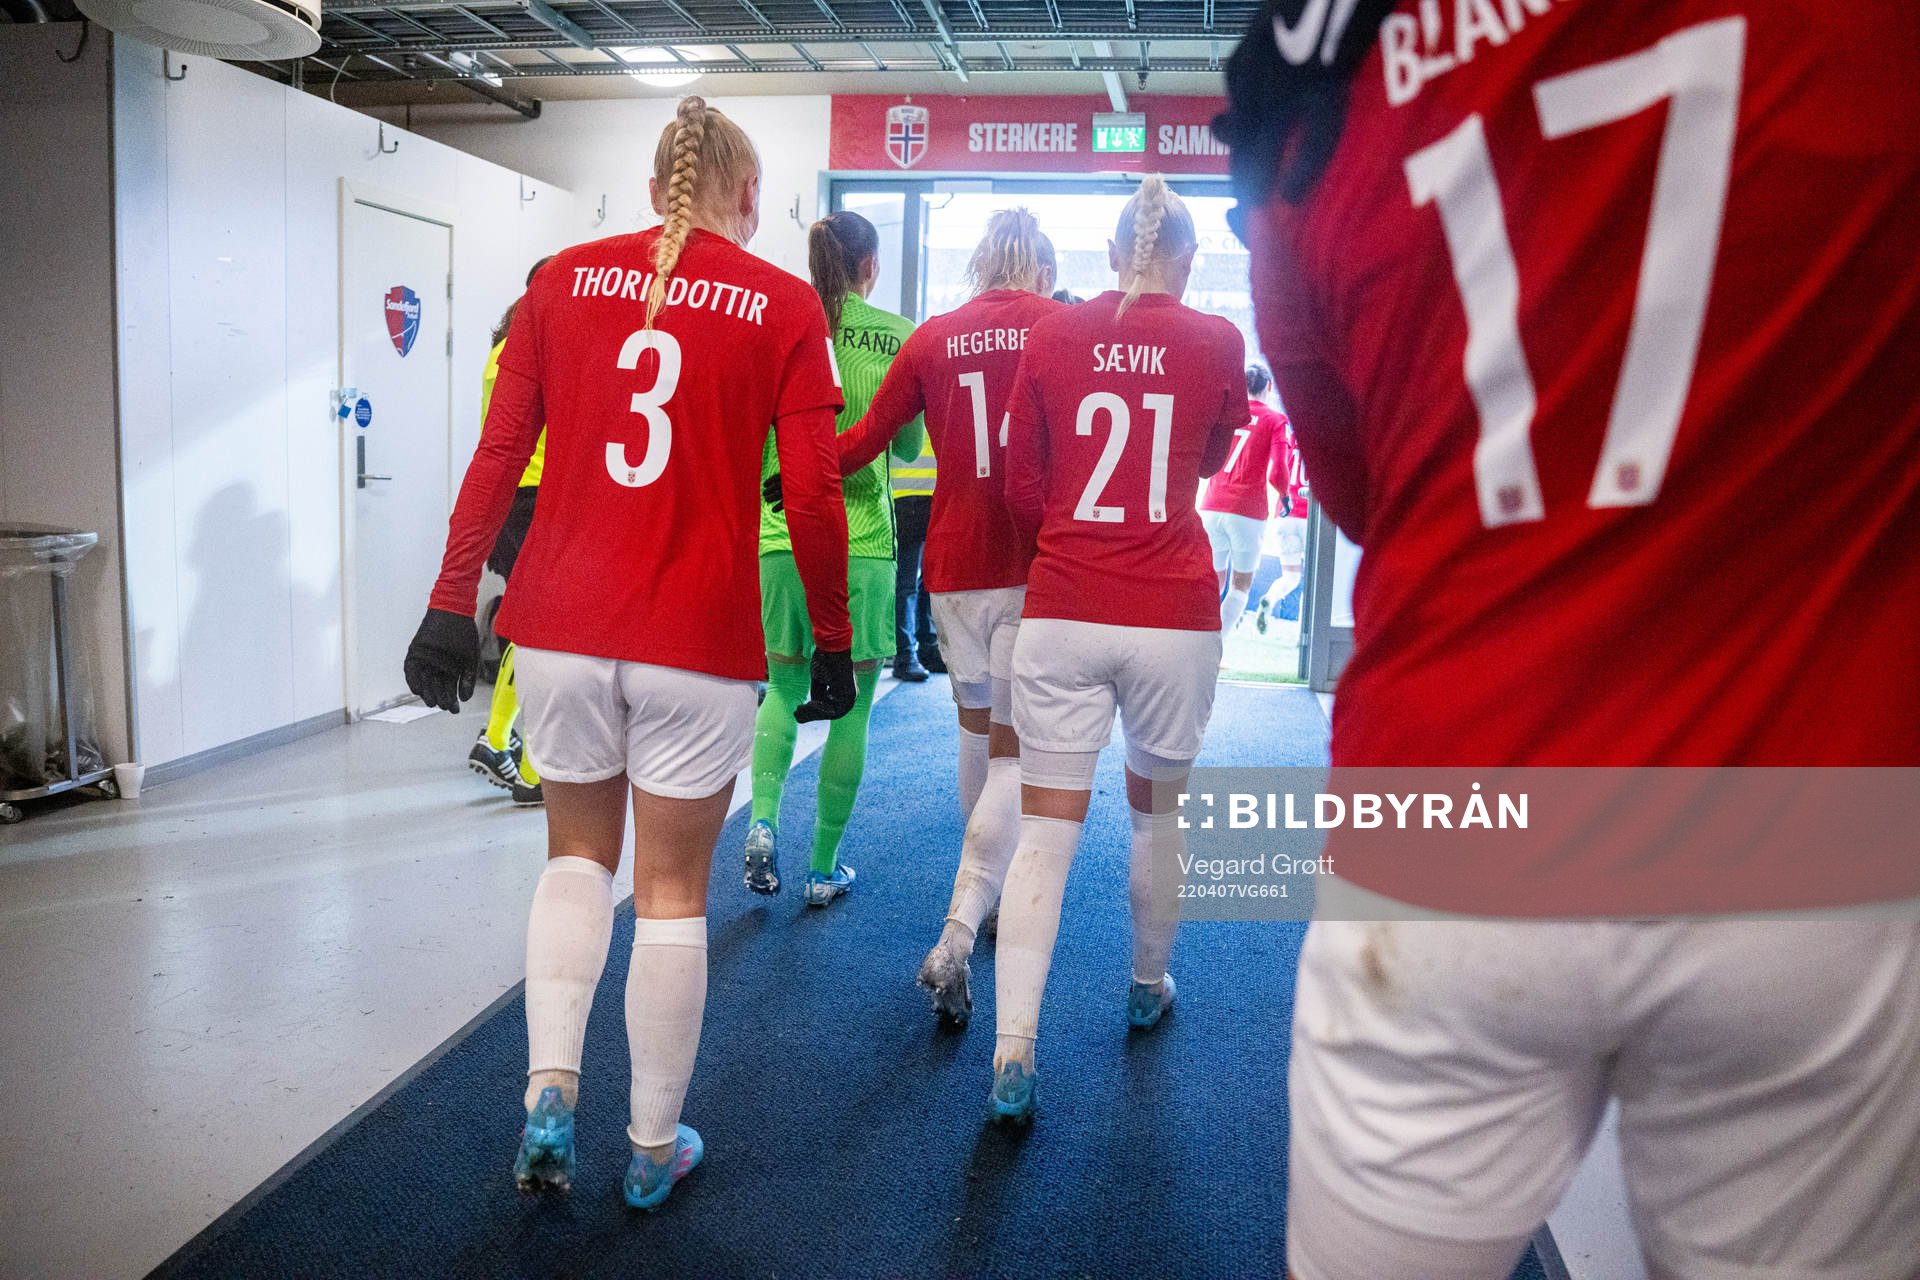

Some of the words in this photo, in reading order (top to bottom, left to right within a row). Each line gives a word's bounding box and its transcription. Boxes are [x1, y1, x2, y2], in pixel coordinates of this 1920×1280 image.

[968, 123, 1078, 153] STERKERE
[572, 267, 769, 326] THORIDOTTIR
[1404, 16, 1747, 529] 17
[1093, 343, 1167, 375] SÆVIK
[605, 329, 682, 488] 3
[1073, 391, 1175, 524] 21
[1223, 428, 1252, 473] 7
